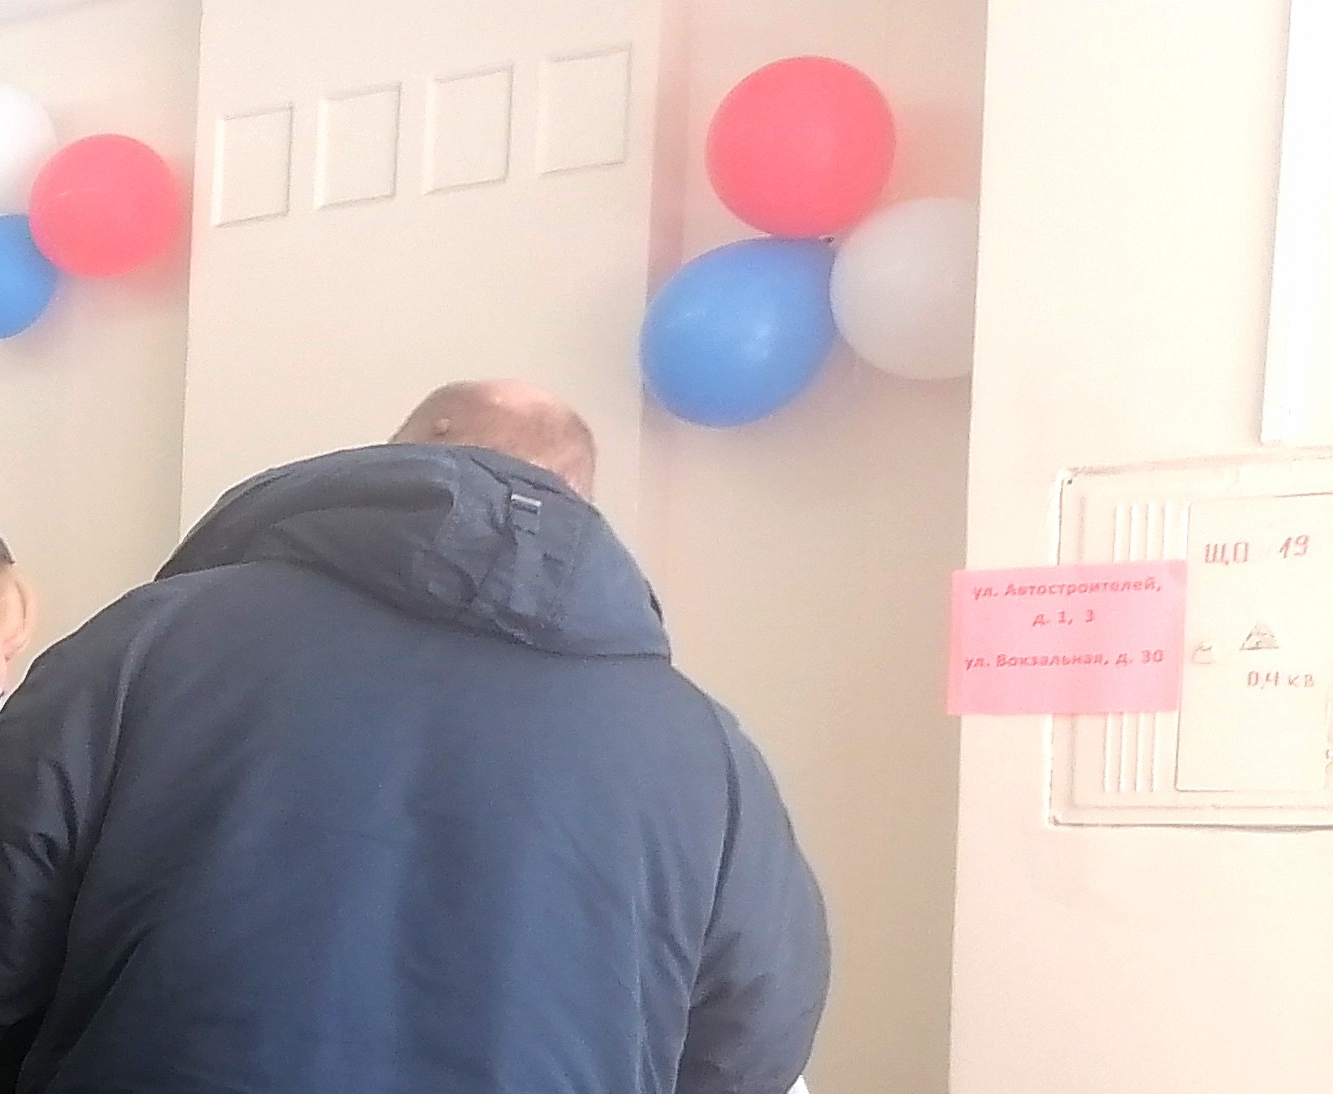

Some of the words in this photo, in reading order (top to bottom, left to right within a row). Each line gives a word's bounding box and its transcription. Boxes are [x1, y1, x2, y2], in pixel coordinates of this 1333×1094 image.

[1278, 534, 1311, 560] 19
[973, 586, 998, 600] ул.
[1005, 576, 1162, 597] Автостроителей,
[965, 656, 990, 671] ул.
[996, 653, 1109, 668] Вокзальная,
